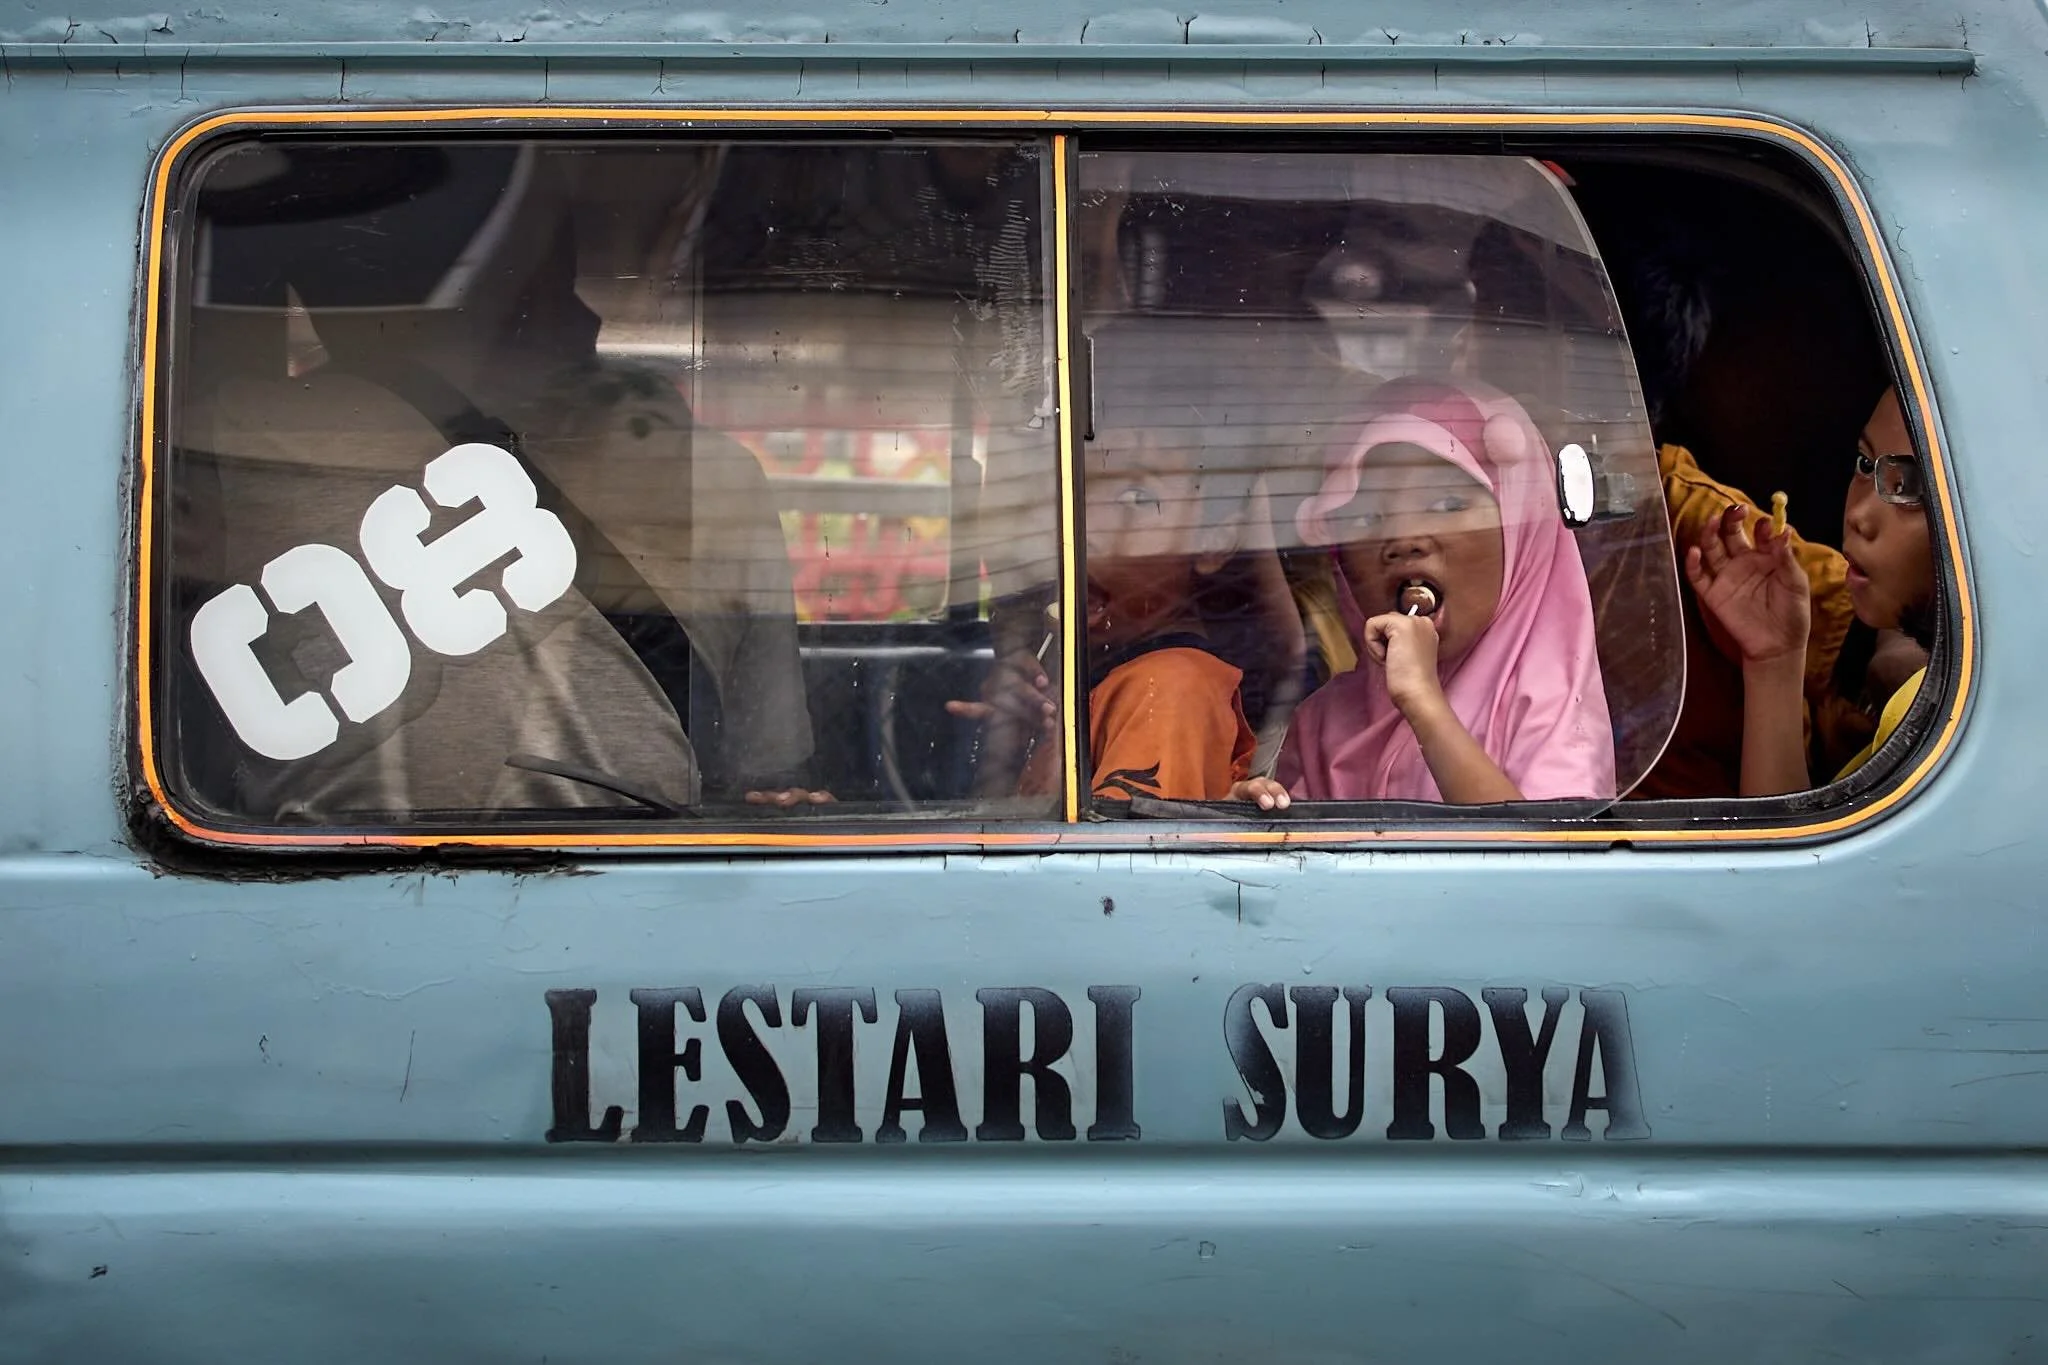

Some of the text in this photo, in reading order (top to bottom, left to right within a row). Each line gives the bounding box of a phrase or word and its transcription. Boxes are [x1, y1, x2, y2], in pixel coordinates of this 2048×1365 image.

[190, 442, 577, 760] 08
[545, 983, 1651, 1143] LESTARI SURYA
